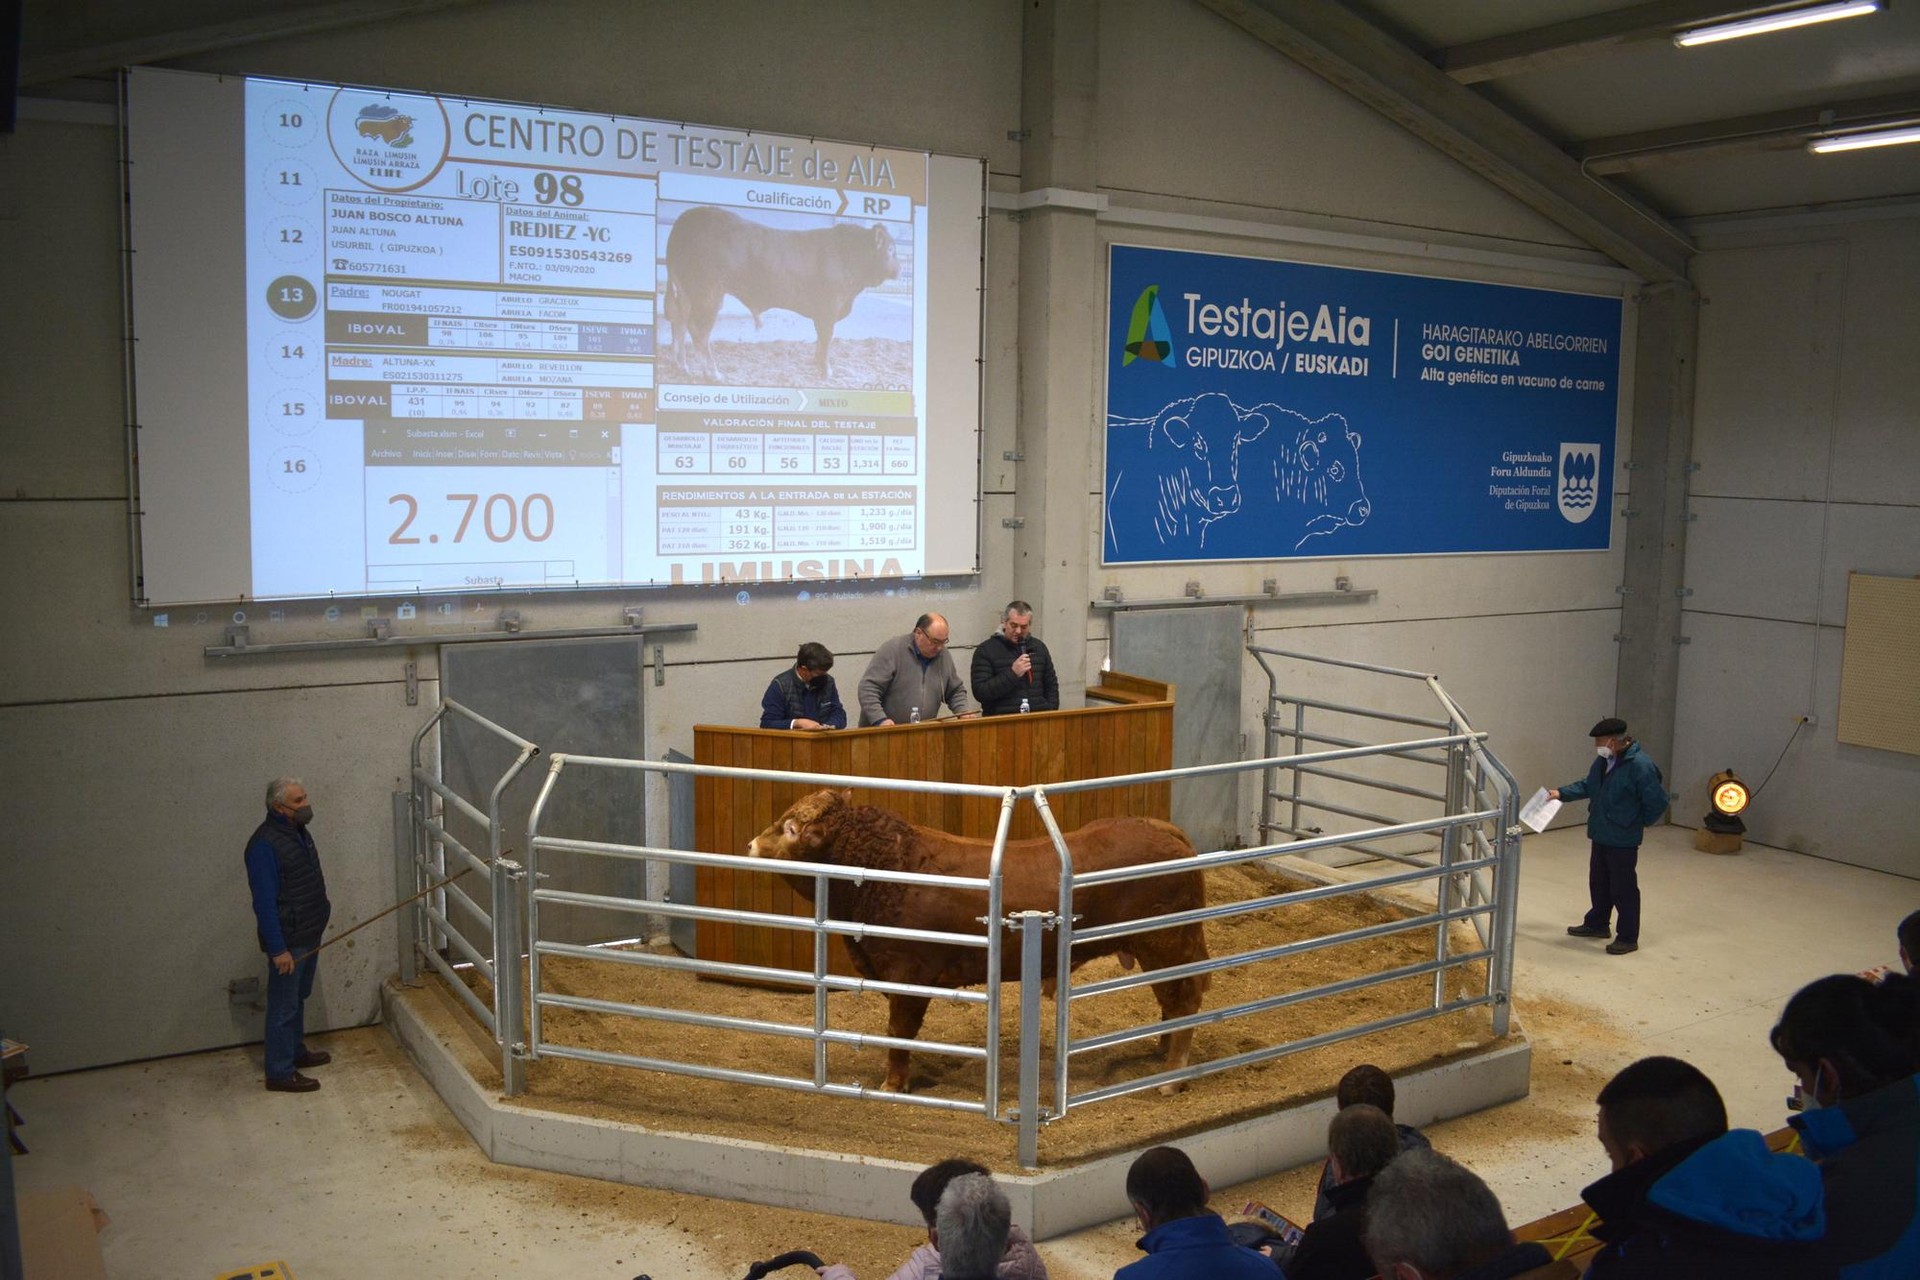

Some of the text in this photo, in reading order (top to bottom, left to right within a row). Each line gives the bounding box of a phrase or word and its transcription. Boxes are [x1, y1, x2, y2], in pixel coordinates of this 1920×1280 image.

[279, 113, 303, 128] 10
[356, 148, 417, 160] RAZA LIMUSIN
[464, 112, 896, 189] CENTRO DE TESTAJE de AIA
[353, 157, 420, 169] LIMUSIN ARRAZA
[279, 171, 303, 186] 11
[456, 168, 585, 207] Lote 98
[331, 193, 444, 210] Datos del Propietario:
[746, 189, 832, 210] Cualificación
[863, 196, 891, 216] RP
[331, 208, 464, 227] JUAN BOSCO ALTUNA
[505, 206, 589, 221] Datos del Animal:
[279, 229, 303, 244] 12
[331, 225, 397, 237] JUAN ALTUNA
[509, 220, 577, 241] REDIEZ
[331, 240, 375, 251] USURBIL
[387, 243, 437, 255] GIPUZKOA
[509, 245, 633, 264] ES091530543269
[349, 261, 407, 274] 605771631
[544, 264, 596, 274] 03/09/2020
[509, 272, 542, 282] MACHO
[280, 287, 304, 302] 13
[331, 285, 422, 299] Padre: NOUGAT
[1183, 292, 1371, 350] TestajeAia
[347, 323, 407, 336] IBOVAL
[1422, 322, 1608, 355] HARAGITARAKO ABELGORRIEN
[281, 345, 305, 359] 14
[1421, 343, 1520, 367] GOI GENETIKA
[331, 355, 436, 368] Madre: ALTUNA-XX
[1186, 346, 1276, 371] GIPUZKOA
[1295, 352, 1369, 376] EUSKADI
[1420, 366, 1606, 391] Alta genética en vacuno de carne
[329, 395, 388, 406] IBOVAL
[663, 391, 790, 406] Consejo de Utilización
[282, 402, 306, 416] 15
[703, 416, 877, 430] VALORACIÓN FINAL DEL TESTAJE
[675, 456, 909, 470] 63 60 56 53 1,314 660
[1502, 451, 1553, 465] Gipuzkoako
[283, 459, 307, 474] 16
[1490, 465, 1552, 478] Foru Aldundia
[662, 490, 746, 501] RENDIMIENTOS
[749, 490, 758, 500] A
[760, 490, 775, 501] LA
[778, 490, 830, 501] ENTRADA
[861, 488, 912, 500] ESTACIÓN
[1489, 484, 1551, 498] Diputación Foral
[1504, 498, 1550, 513] de Gipuzkoa
[388, 493, 554, 545] 2.700
[735, 508, 750, 519] 43
[753, 509, 771, 520] Kg.
[728, 524, 750, 535] 191
[753, 525, 771, 536] Kg.
[860, 522, 887, 533] 1,900
[728, 539, 751, 550] 362
[753, 540, 771, 551] Kg.
[464, 575, 504, 586] Subasta
